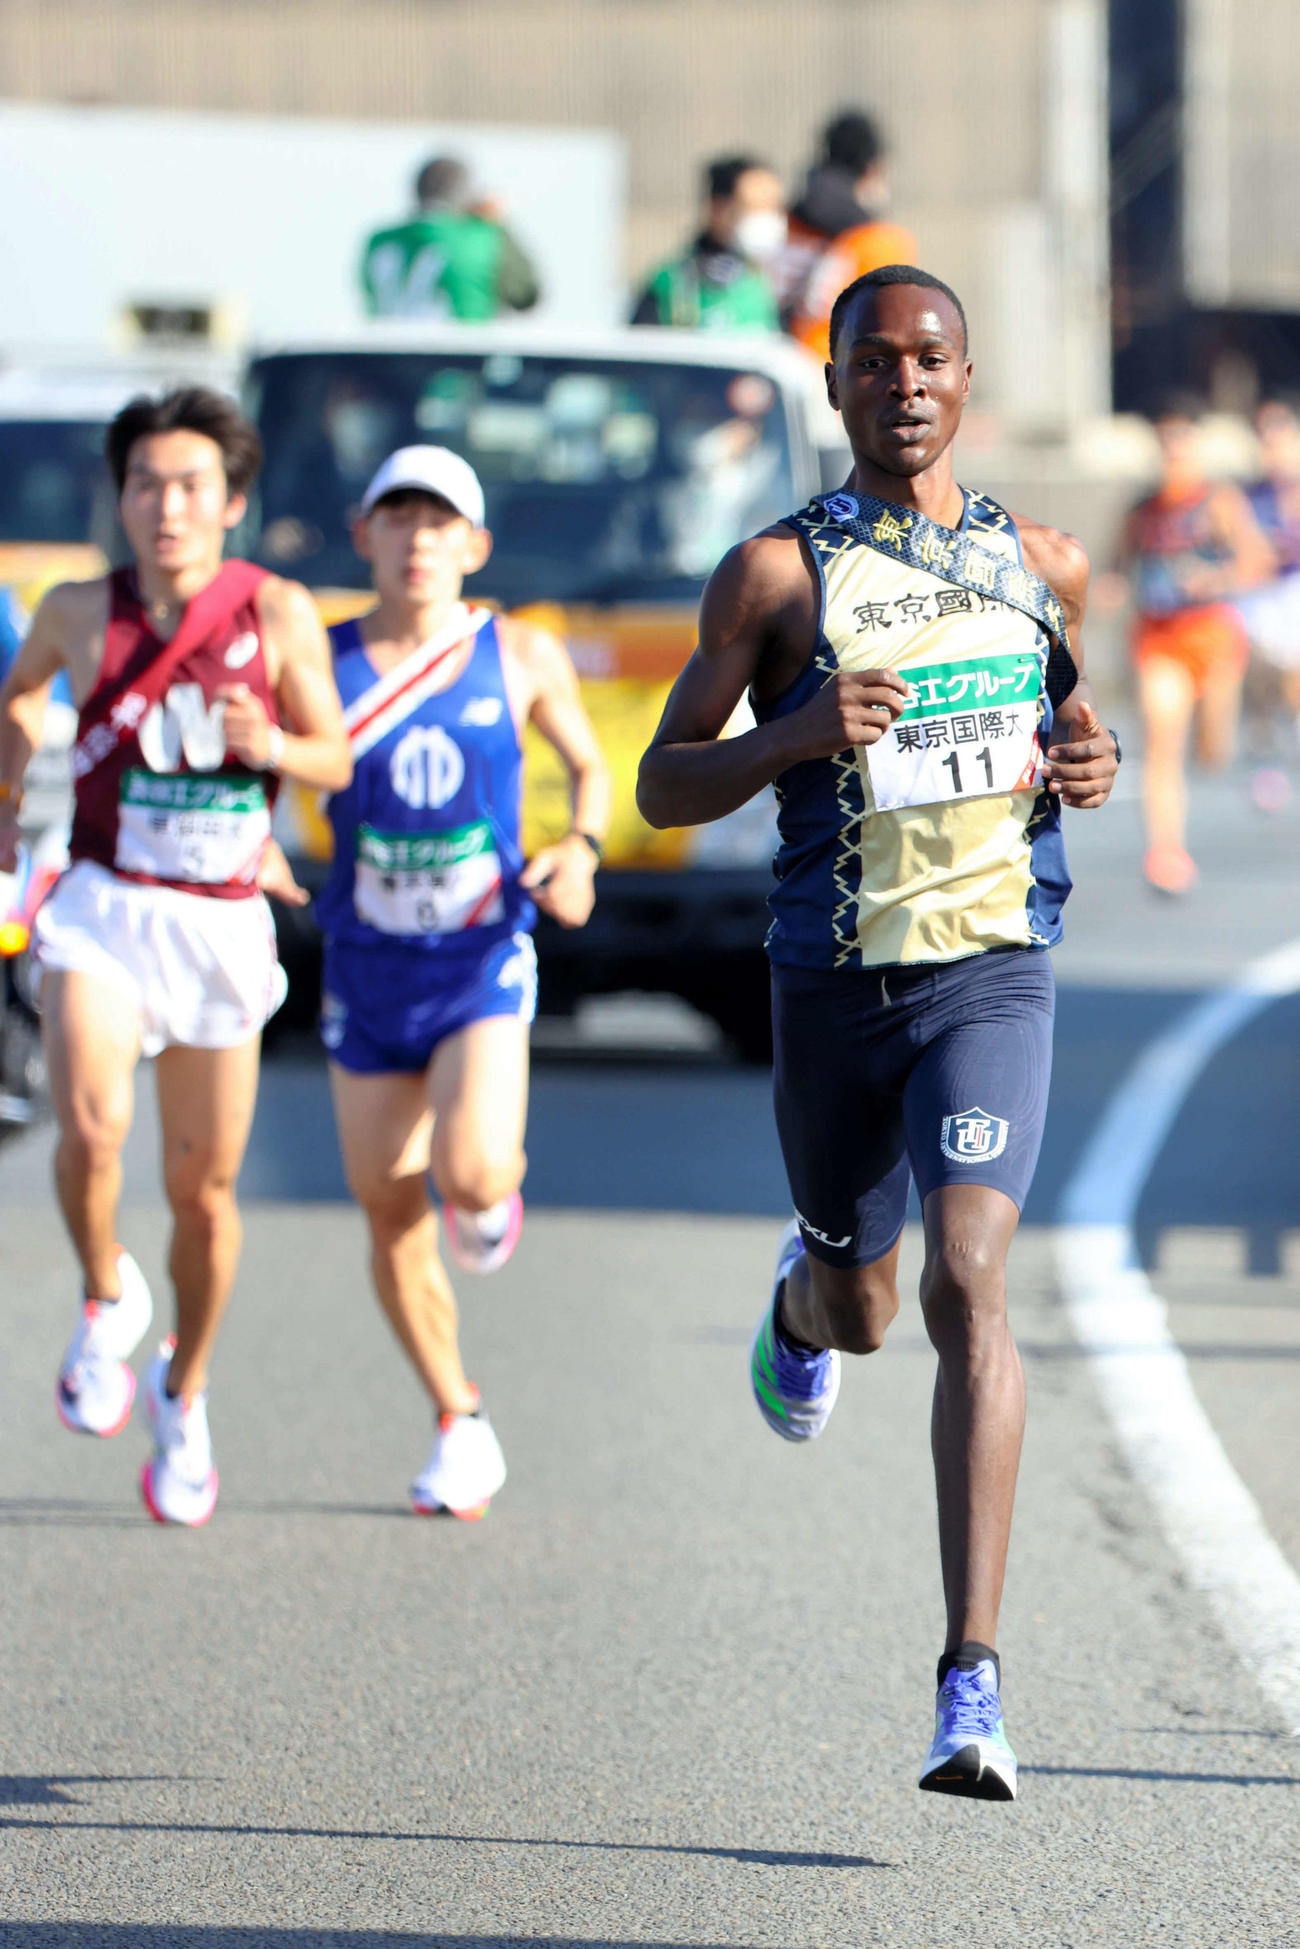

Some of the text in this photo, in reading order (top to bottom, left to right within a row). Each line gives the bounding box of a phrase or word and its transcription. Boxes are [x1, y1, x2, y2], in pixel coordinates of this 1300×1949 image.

[874, 664, 1036, 711] 谷工グループ
[894, 710, 1024, 754] 東京国際大
[942, 747, 994, 793] 11
[794, 1206, 853, 1248] XU
